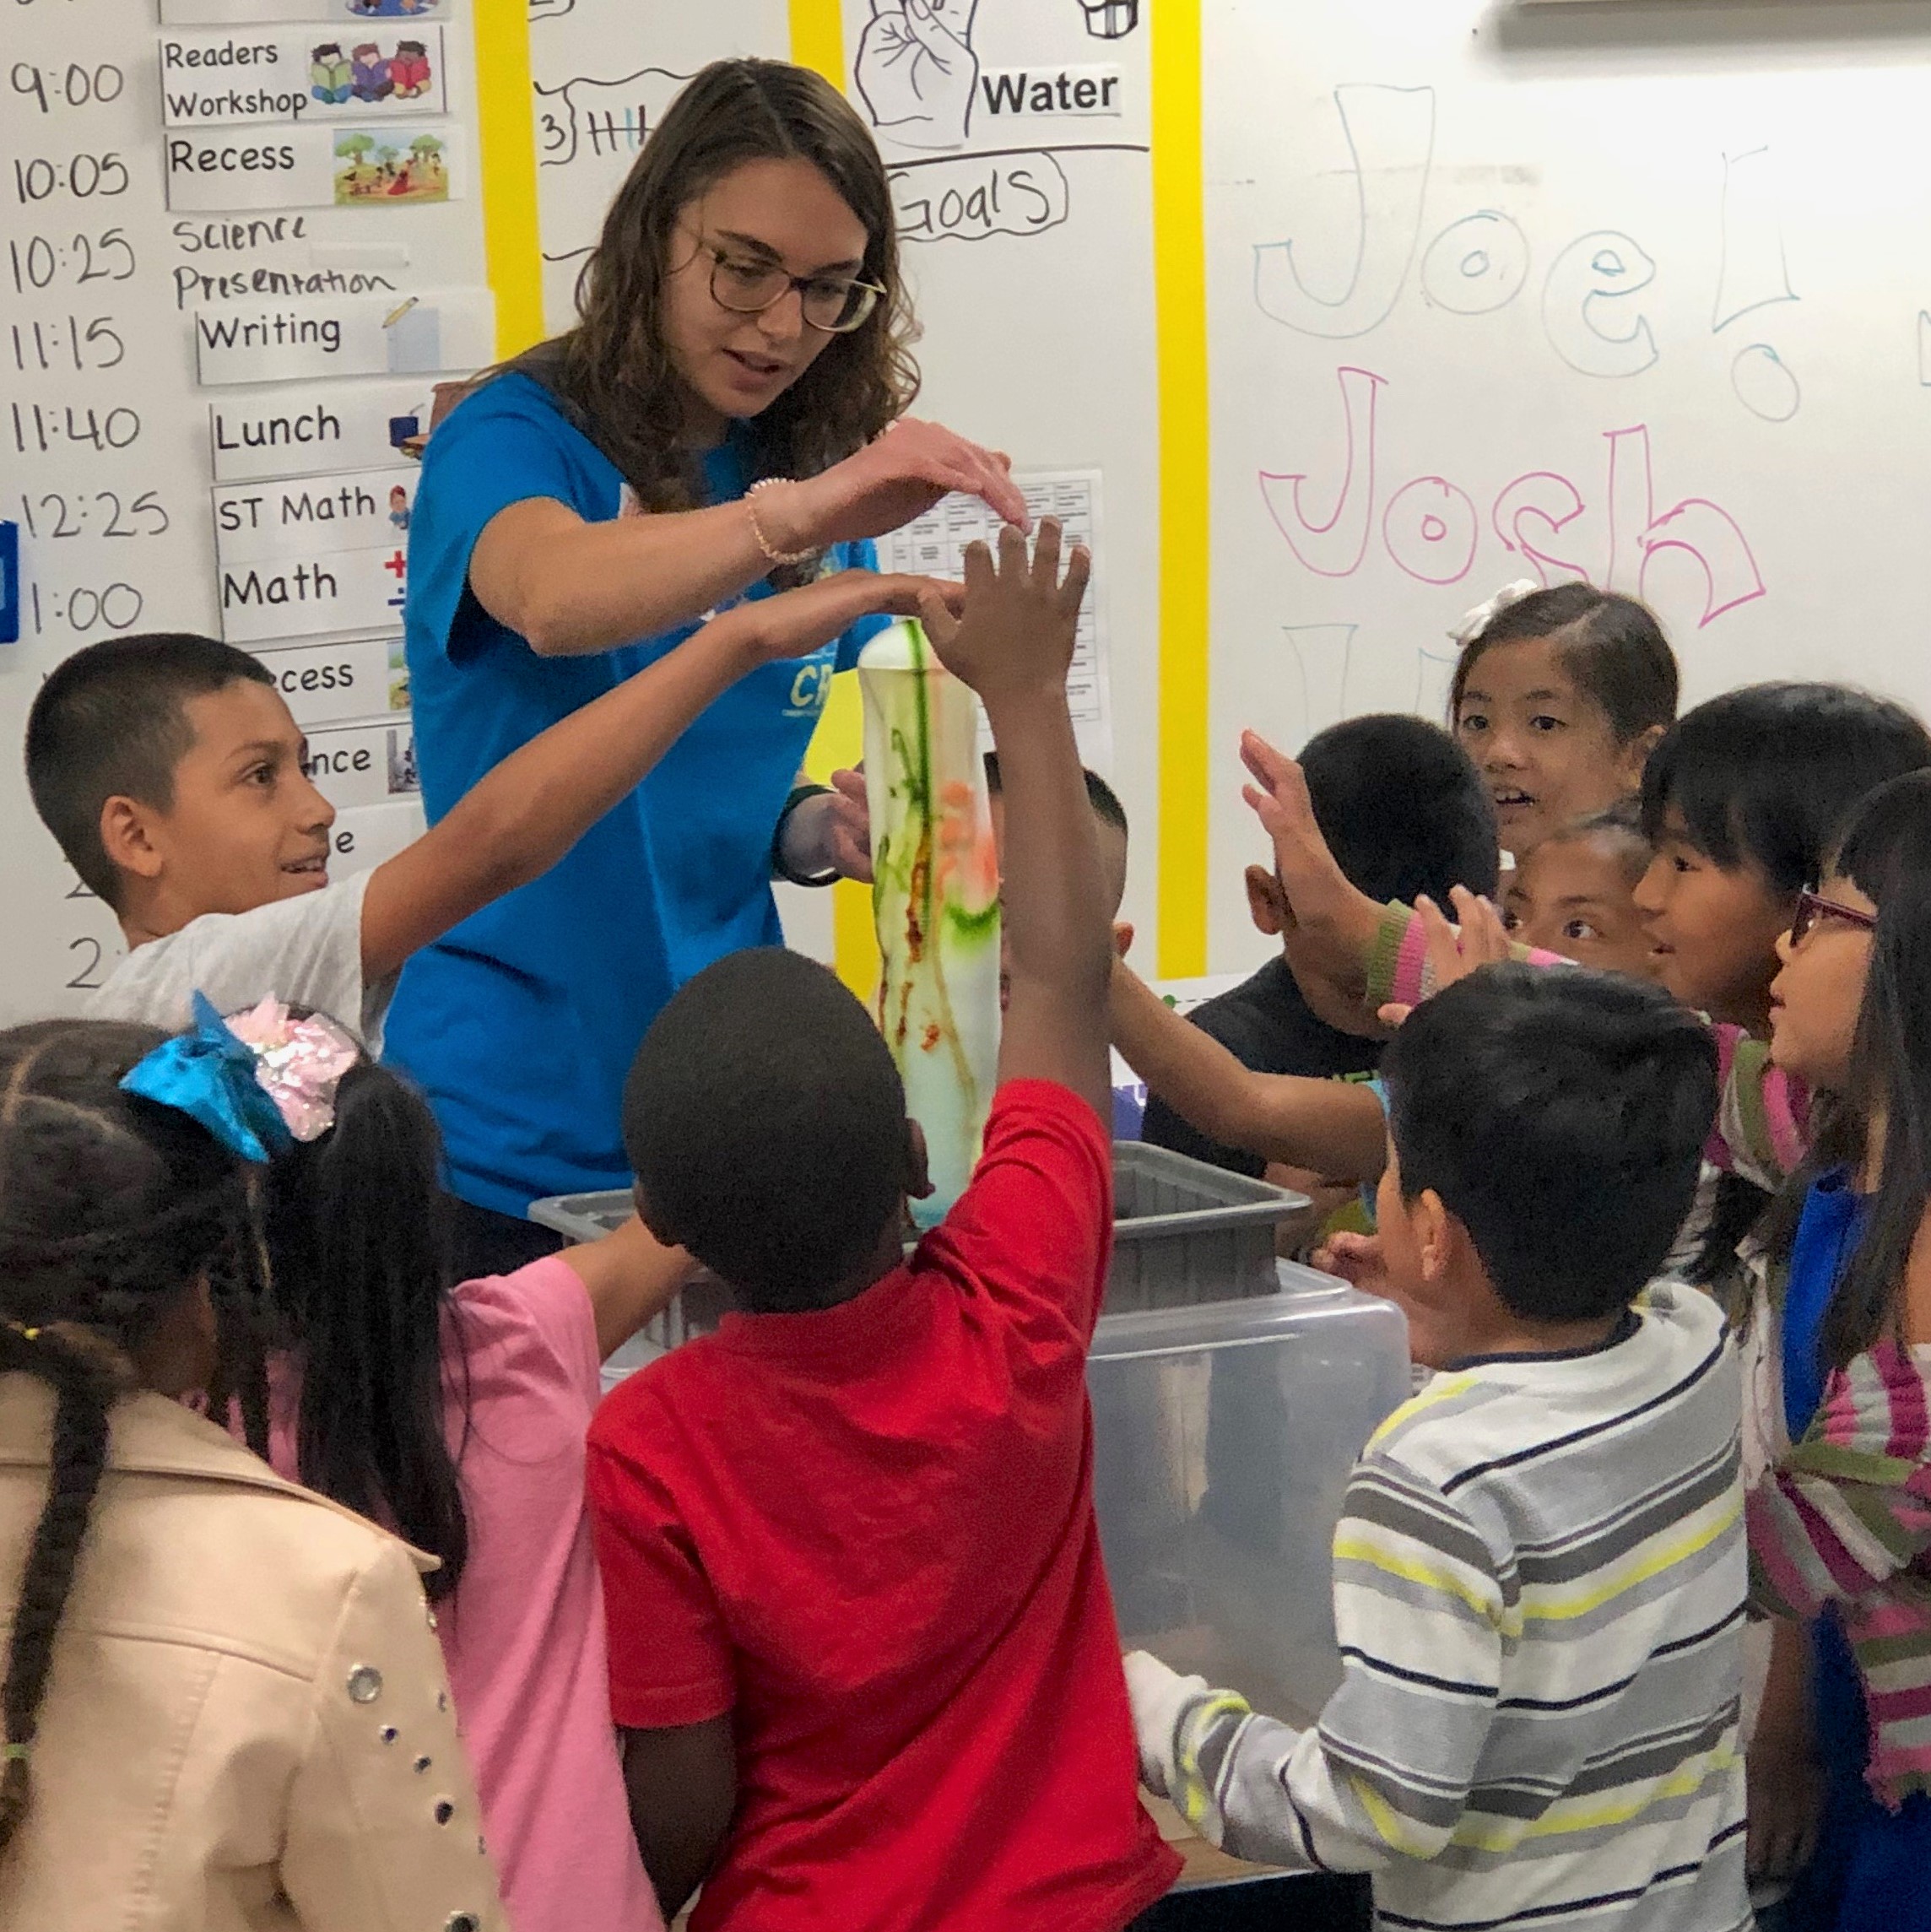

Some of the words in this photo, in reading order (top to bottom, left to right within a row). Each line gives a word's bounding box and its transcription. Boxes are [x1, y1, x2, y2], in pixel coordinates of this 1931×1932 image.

[165, 41, 279, 68] Readers
[11, 62, 124, 113] 9:00
[167, 89, 308, 120] Workshop
[982, 74, 1119, 115] Water
[14, 152, 129, 203] 10:05
[169, 139, 295, 173] Recess
[172, 216, 307, 252] Science
[9, 227, 136, 294] 10:25
[172, 265, 397, 310] Presentation
[11, 315, 125, 371] 11:15
[199, 313, 341, 352] Writing
[11, 402, 141, 452] 11:40
[215, 404, 341, 451] Lunch
[21, 490, 170, 538] 12:25
[219, 497, 264, 531] ST
[282, 485, 376, 524] Math
[1259, 366, 1766, 628] Josh
[31, 582, 143, 634] 1:00
[223, 562, 338, 609] Math
[279, 663, 354, 693] cess
